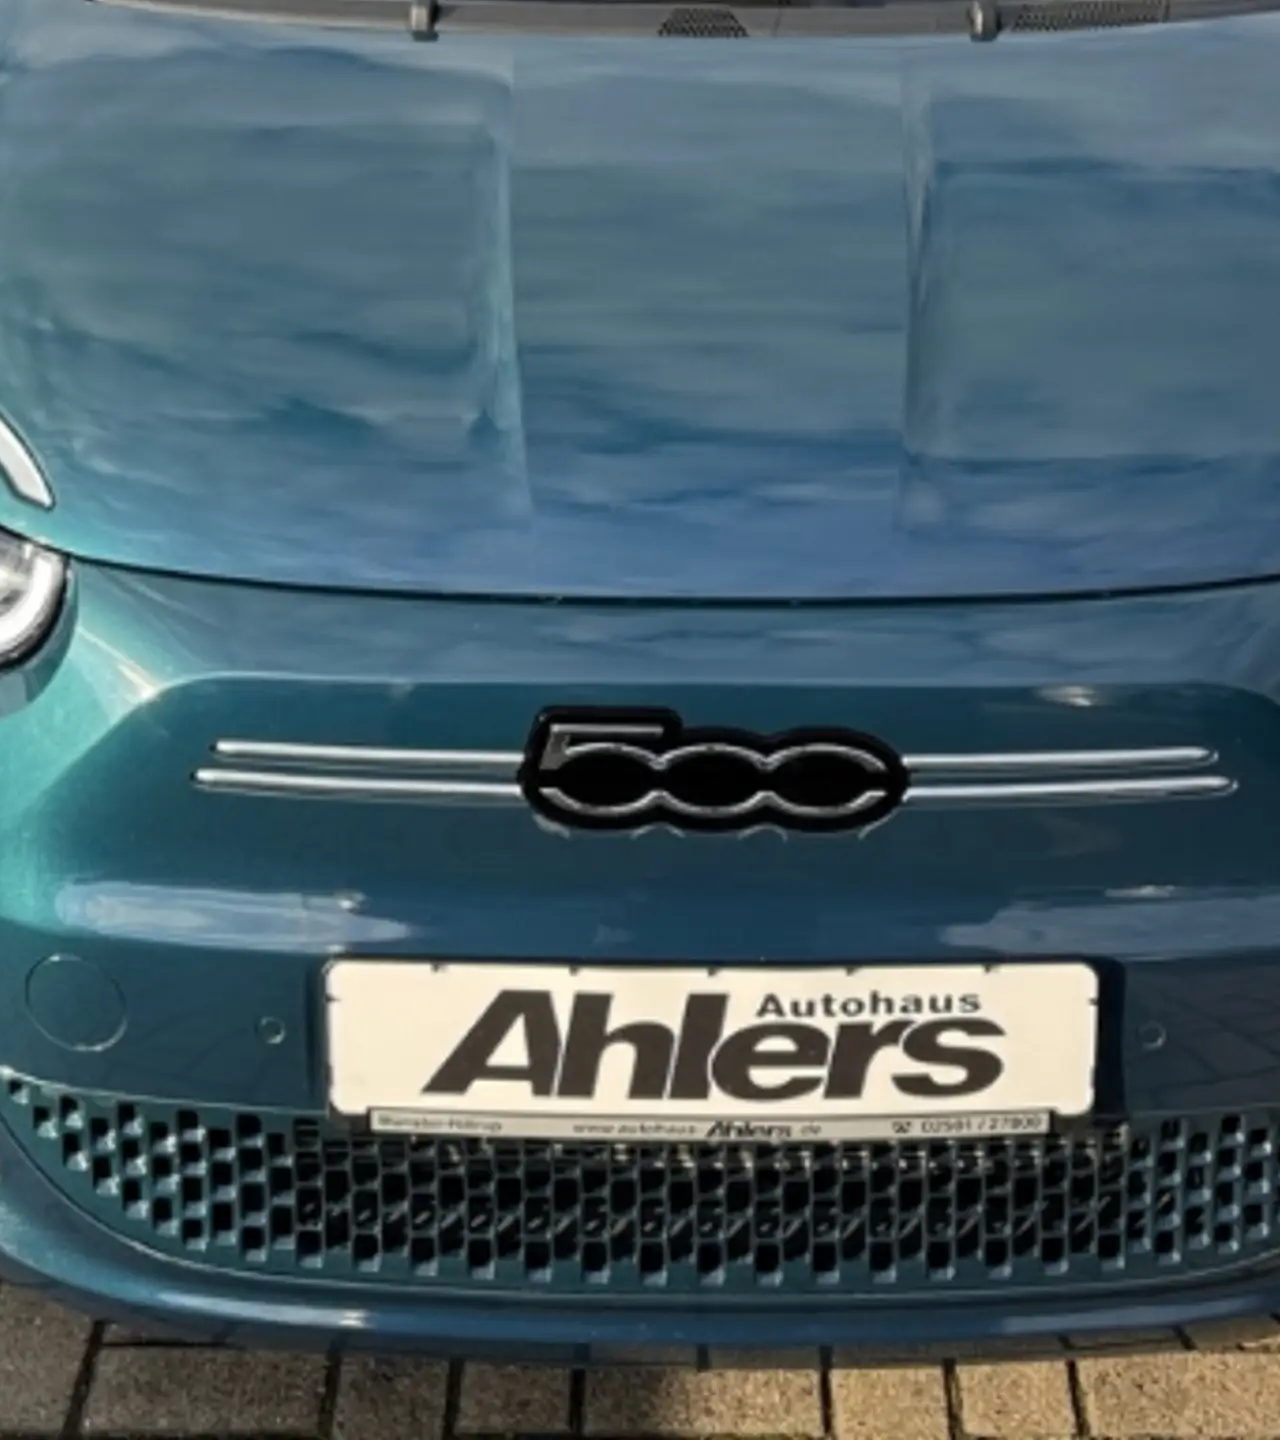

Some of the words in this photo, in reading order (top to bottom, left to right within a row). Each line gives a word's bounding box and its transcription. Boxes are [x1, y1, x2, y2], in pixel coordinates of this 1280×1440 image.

[518, 705, 908, 833] 500
[420, 988, 1007, 1101] Ahlers
[756, 989, 983, 1020] Autohaus
